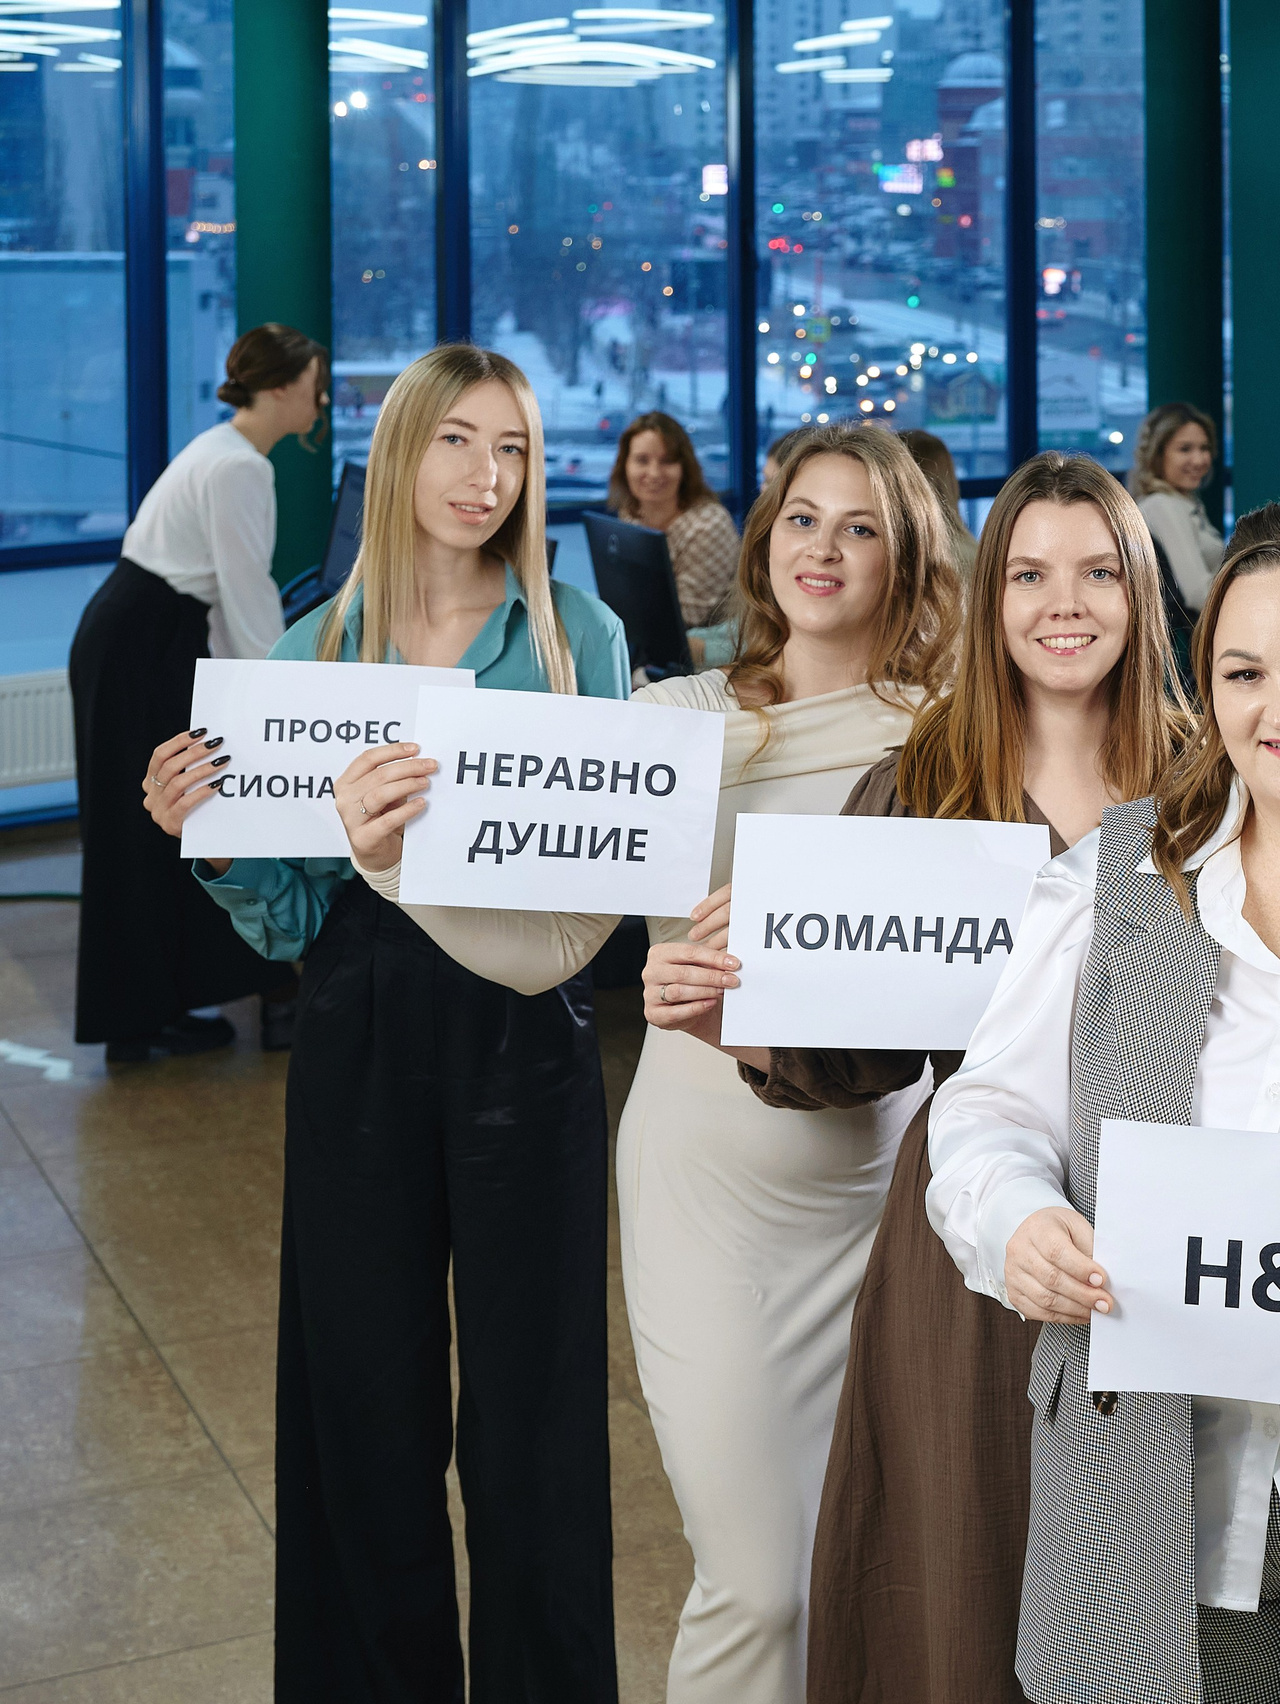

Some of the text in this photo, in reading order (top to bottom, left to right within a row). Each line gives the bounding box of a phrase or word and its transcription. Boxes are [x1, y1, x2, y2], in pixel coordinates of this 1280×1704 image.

[264, 718, 402, 745] ПРОФЕС
[455, 750, 677, 797] НЕРАВНО
[467, 820, 649, 865] ДУШИЕ
[763, 912, 1014, 965] КОМАНДА
